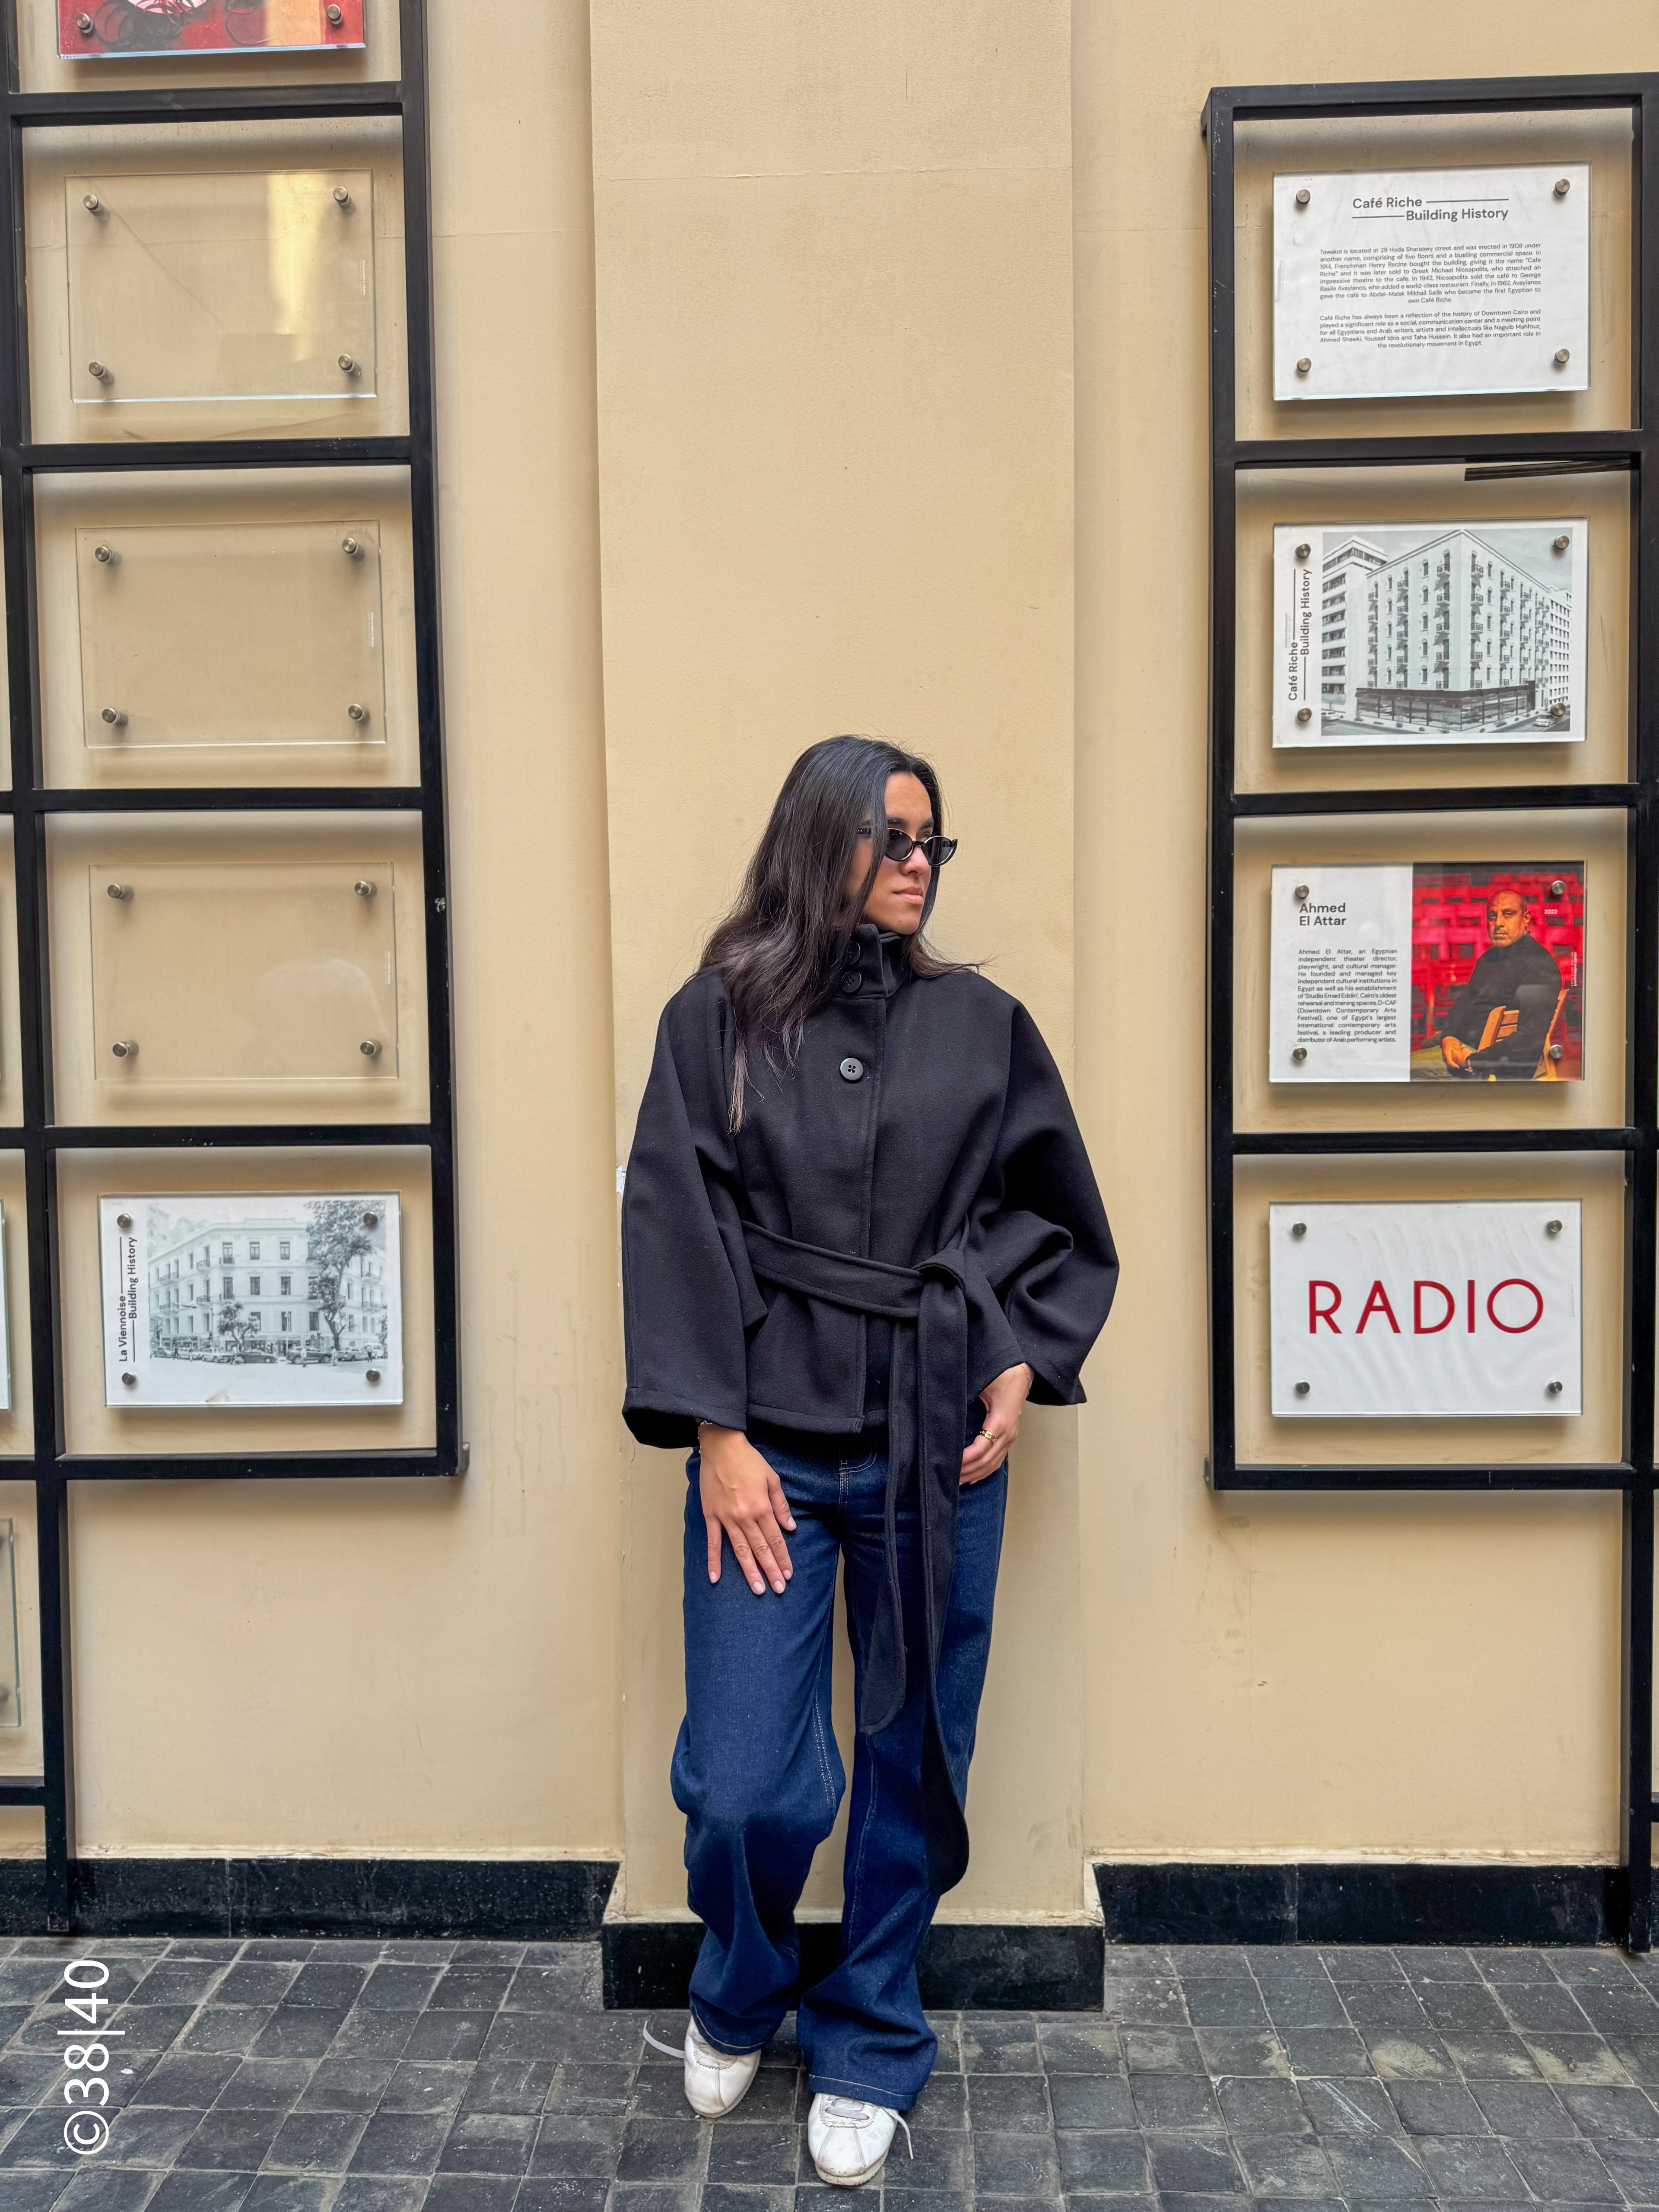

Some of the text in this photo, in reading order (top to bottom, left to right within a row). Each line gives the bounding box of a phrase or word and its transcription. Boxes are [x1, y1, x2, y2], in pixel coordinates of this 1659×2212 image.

[1353, 197, 1422, 209] Café Riche
[1406, 208, 1509, 222] Building History
[1300, 569, 1312, 655] Building History
[1288, 642, 1297, 701] Café Riche
[1299, 902, 1345, 913] Ahmed
[1300, 915, 1347, 925] El Attar
[127, 1237, 138, 1319] Building History
[1309, 1278, 1544, 1334] RADIO
[118, 1295, 127, 1362] La Viennoise
